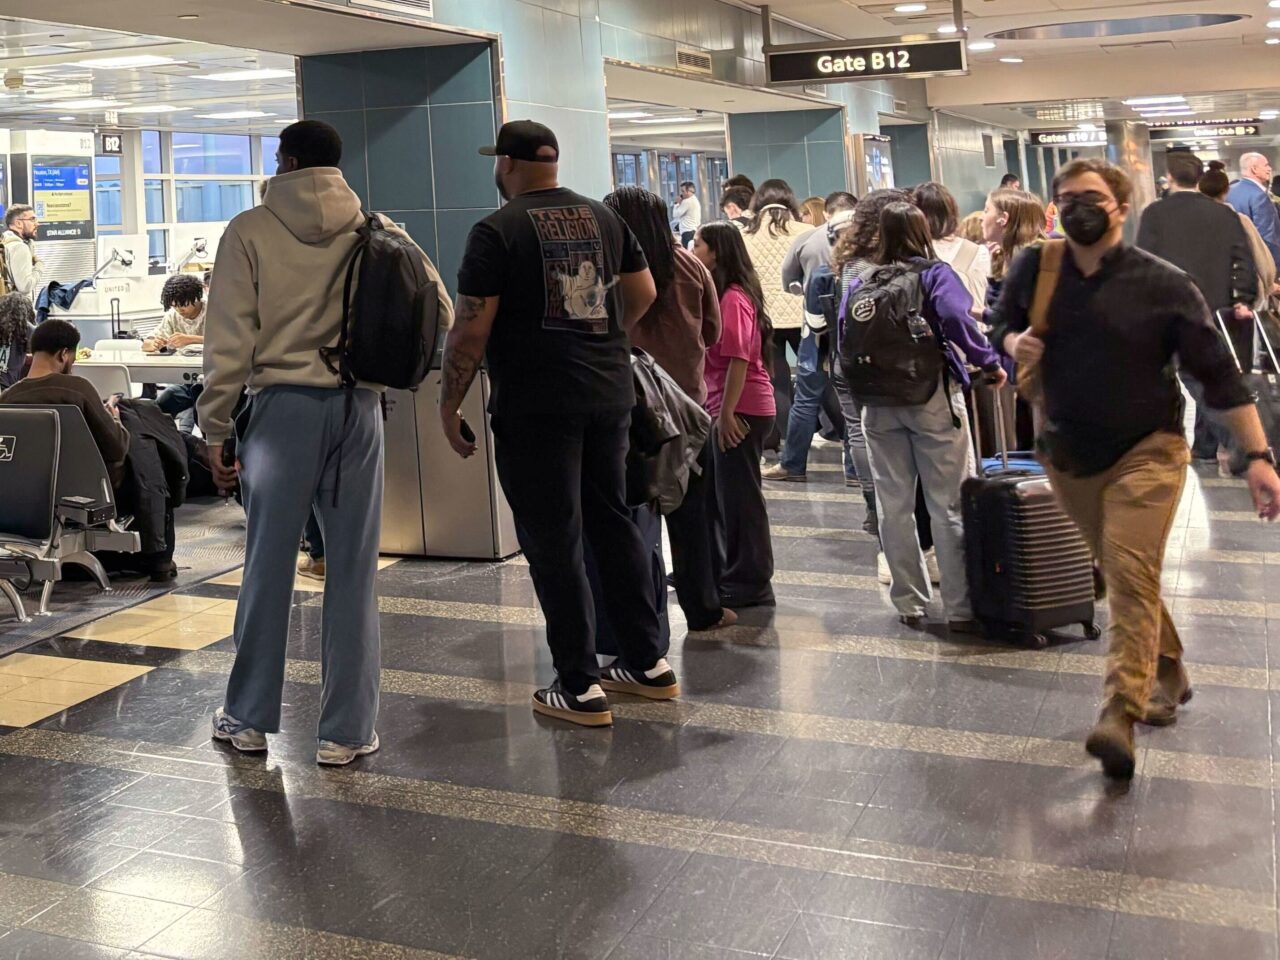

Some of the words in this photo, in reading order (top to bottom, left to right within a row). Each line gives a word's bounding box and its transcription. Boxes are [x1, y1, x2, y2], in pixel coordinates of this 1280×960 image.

[817, 55, 867, 74] Gate
[871, 50, 911, 70] B12
[105, 137, 120, 151] B12
[1038, 133, 1067, 143] Gates
[532, 208, 593, 221] TRUE
[537, 217, 600, 241] RELIGION
